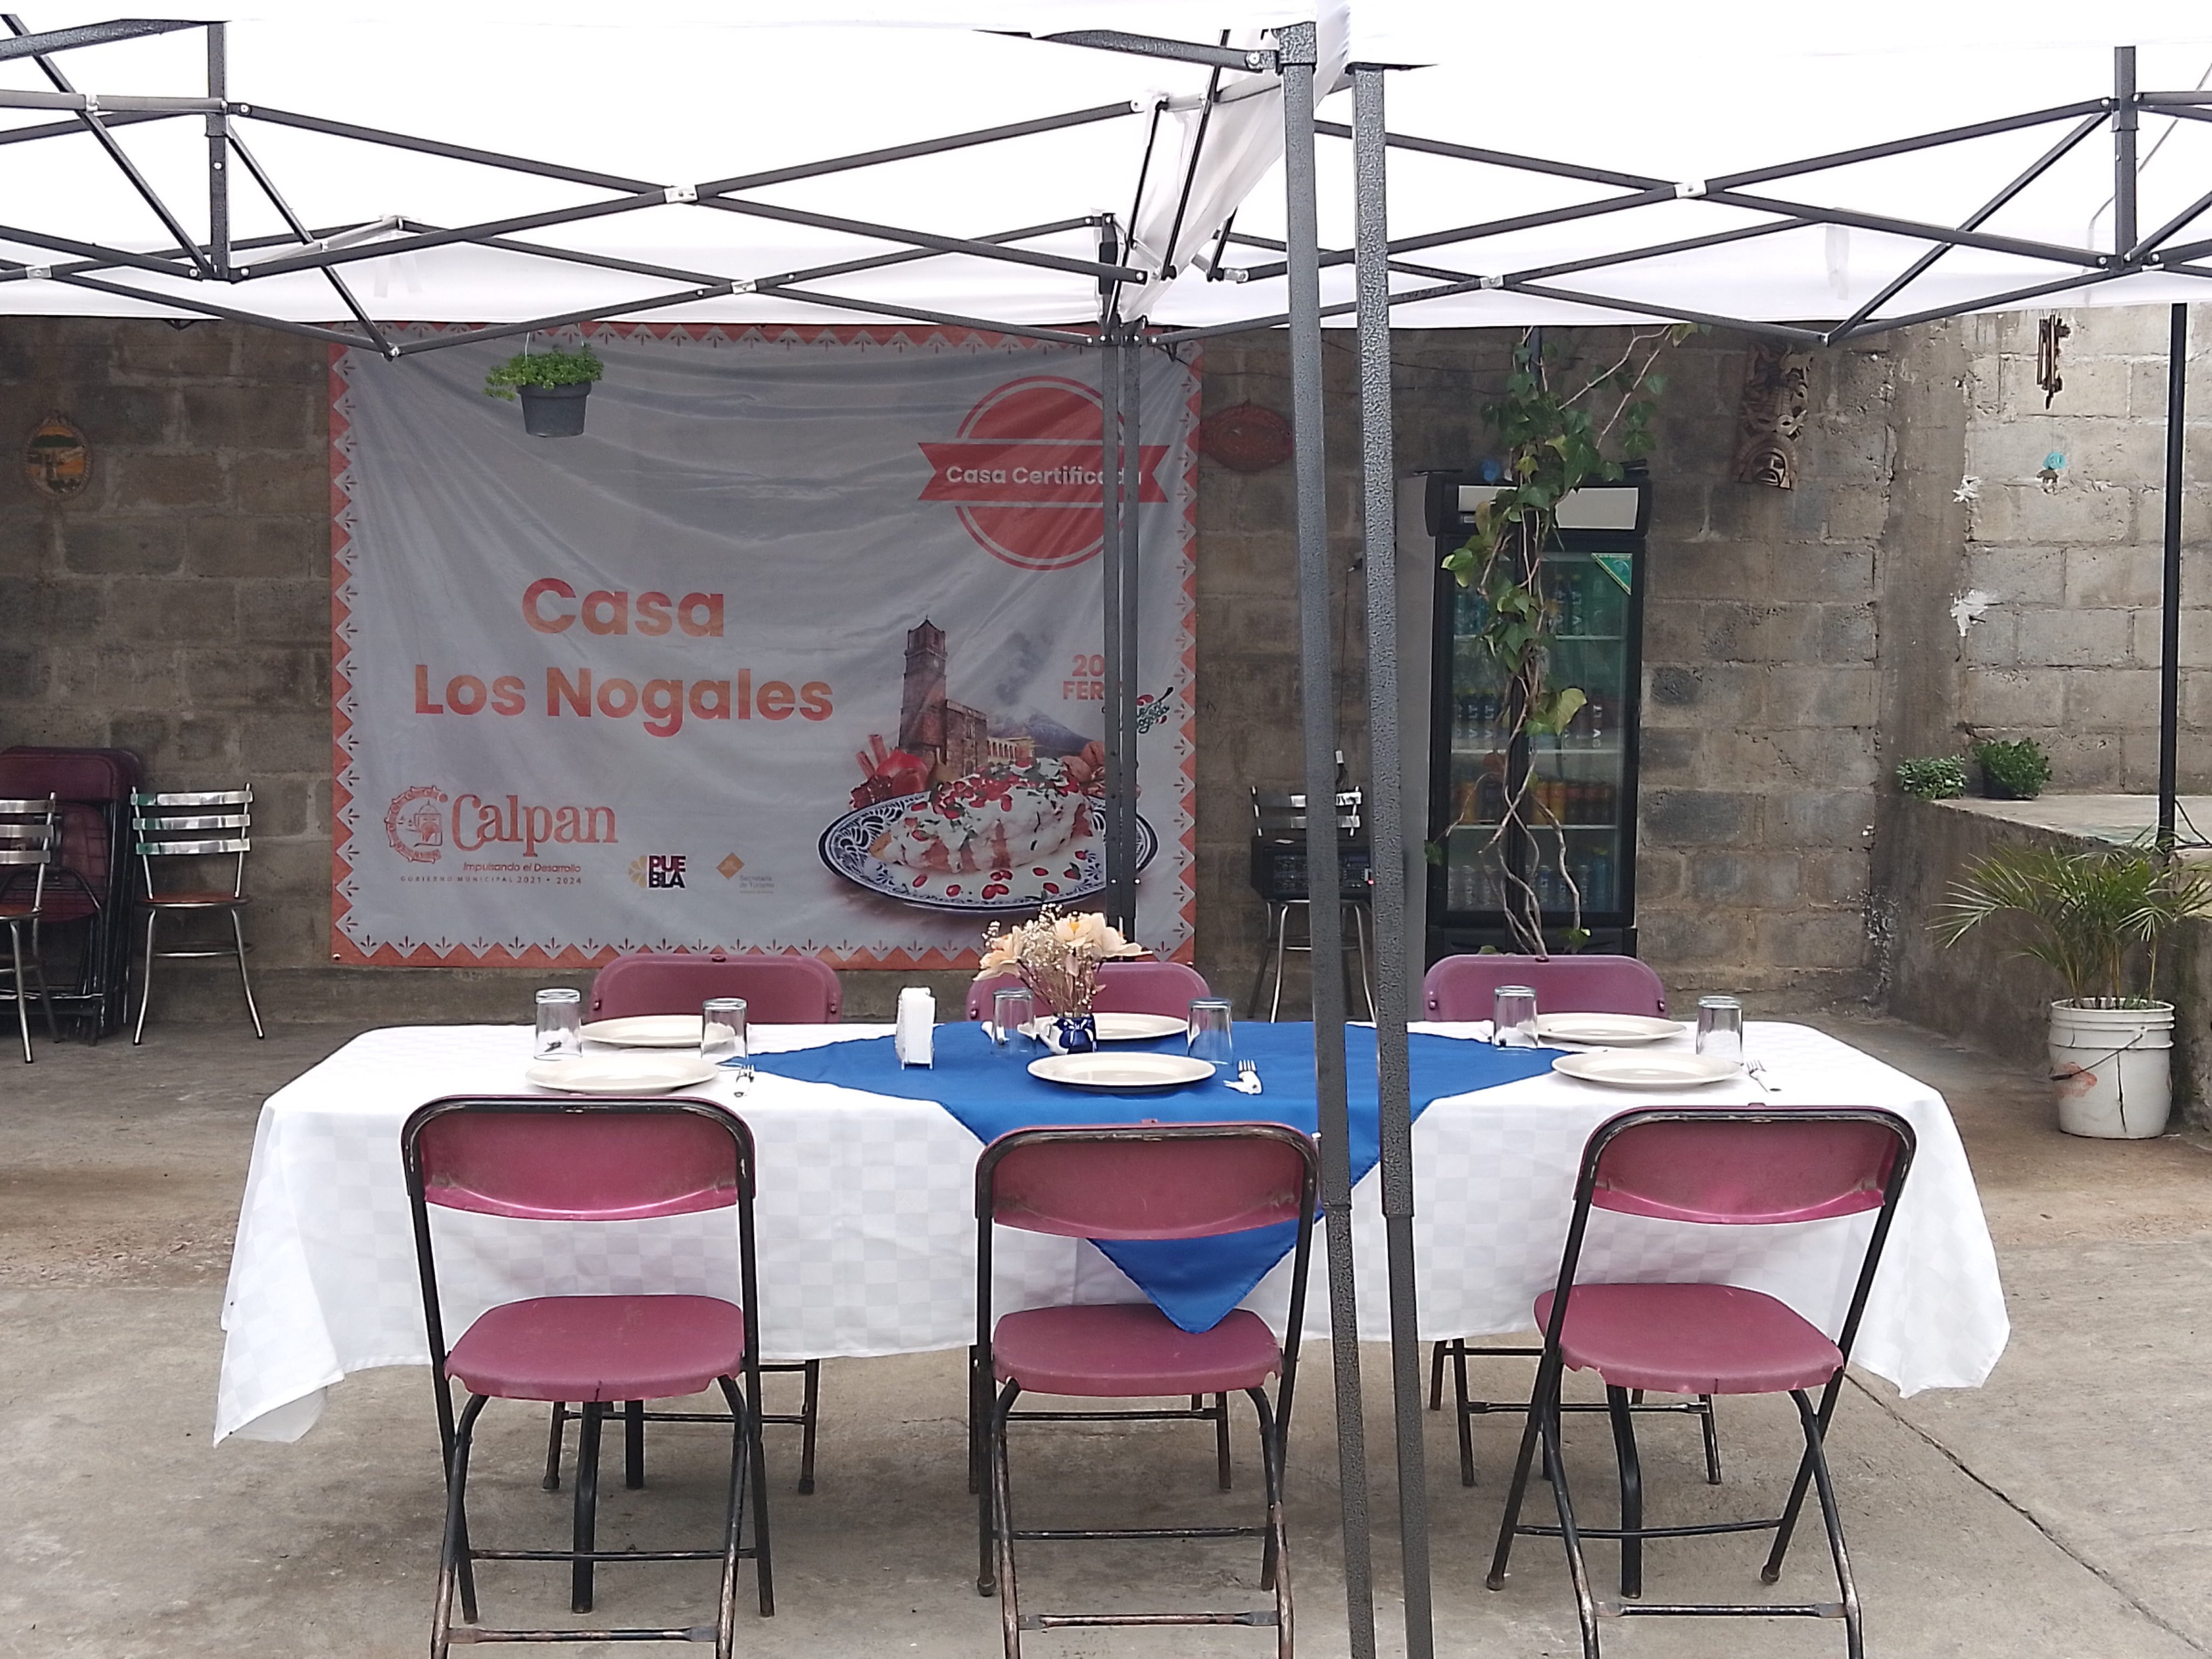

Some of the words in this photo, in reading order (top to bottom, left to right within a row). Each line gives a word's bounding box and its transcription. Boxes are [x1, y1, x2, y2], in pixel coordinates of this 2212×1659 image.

[946, 466, 1006, 484] Casa
[1011, 466, 1141, 485] Certific
[522, 577, 725, 637] Casa
[1063, 681, 1106, 700] FER
[415, 664, 527, 716] Los
[546, 667, 834, 738] Nogales
[451, 793, 618, 858] Calpan
[463, 862, 520, 872] Impulsando
[523, 862, 531, 872] el
[534, 863, 581, 872] Desarrollo
[517, 876, 542, 884] 2021
[556, 877, 582, 885] 2024
